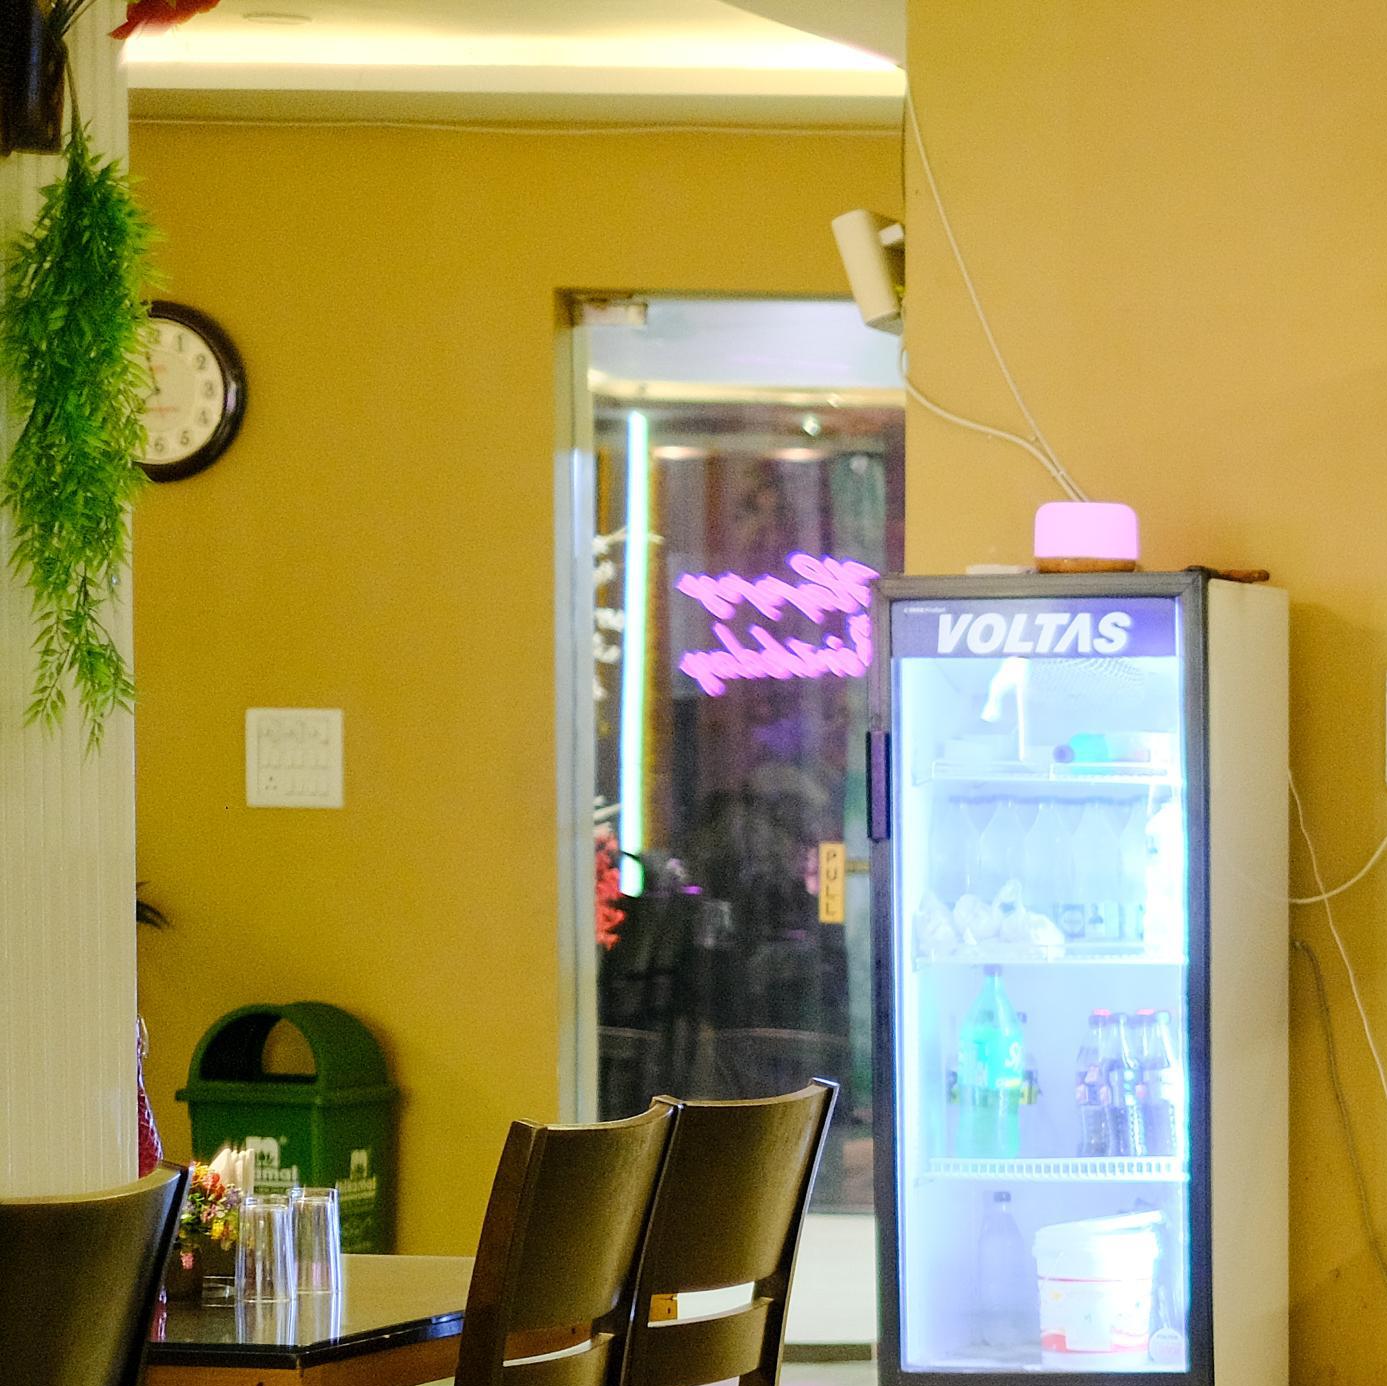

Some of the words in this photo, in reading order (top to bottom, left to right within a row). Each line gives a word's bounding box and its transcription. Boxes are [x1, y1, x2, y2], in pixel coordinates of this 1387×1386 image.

[176, 334, 185, 352] 1
[196, 353, 206, 370] 2
[205, 381, 215, 399] 3
[199, 410, 209, 425] 4
[154, 437, 164, 452] 6
[180, 431, 191, 447] 5
[936, 610, 1132, 655] VOLTAS
[826, 849, 838, 917] PULL
